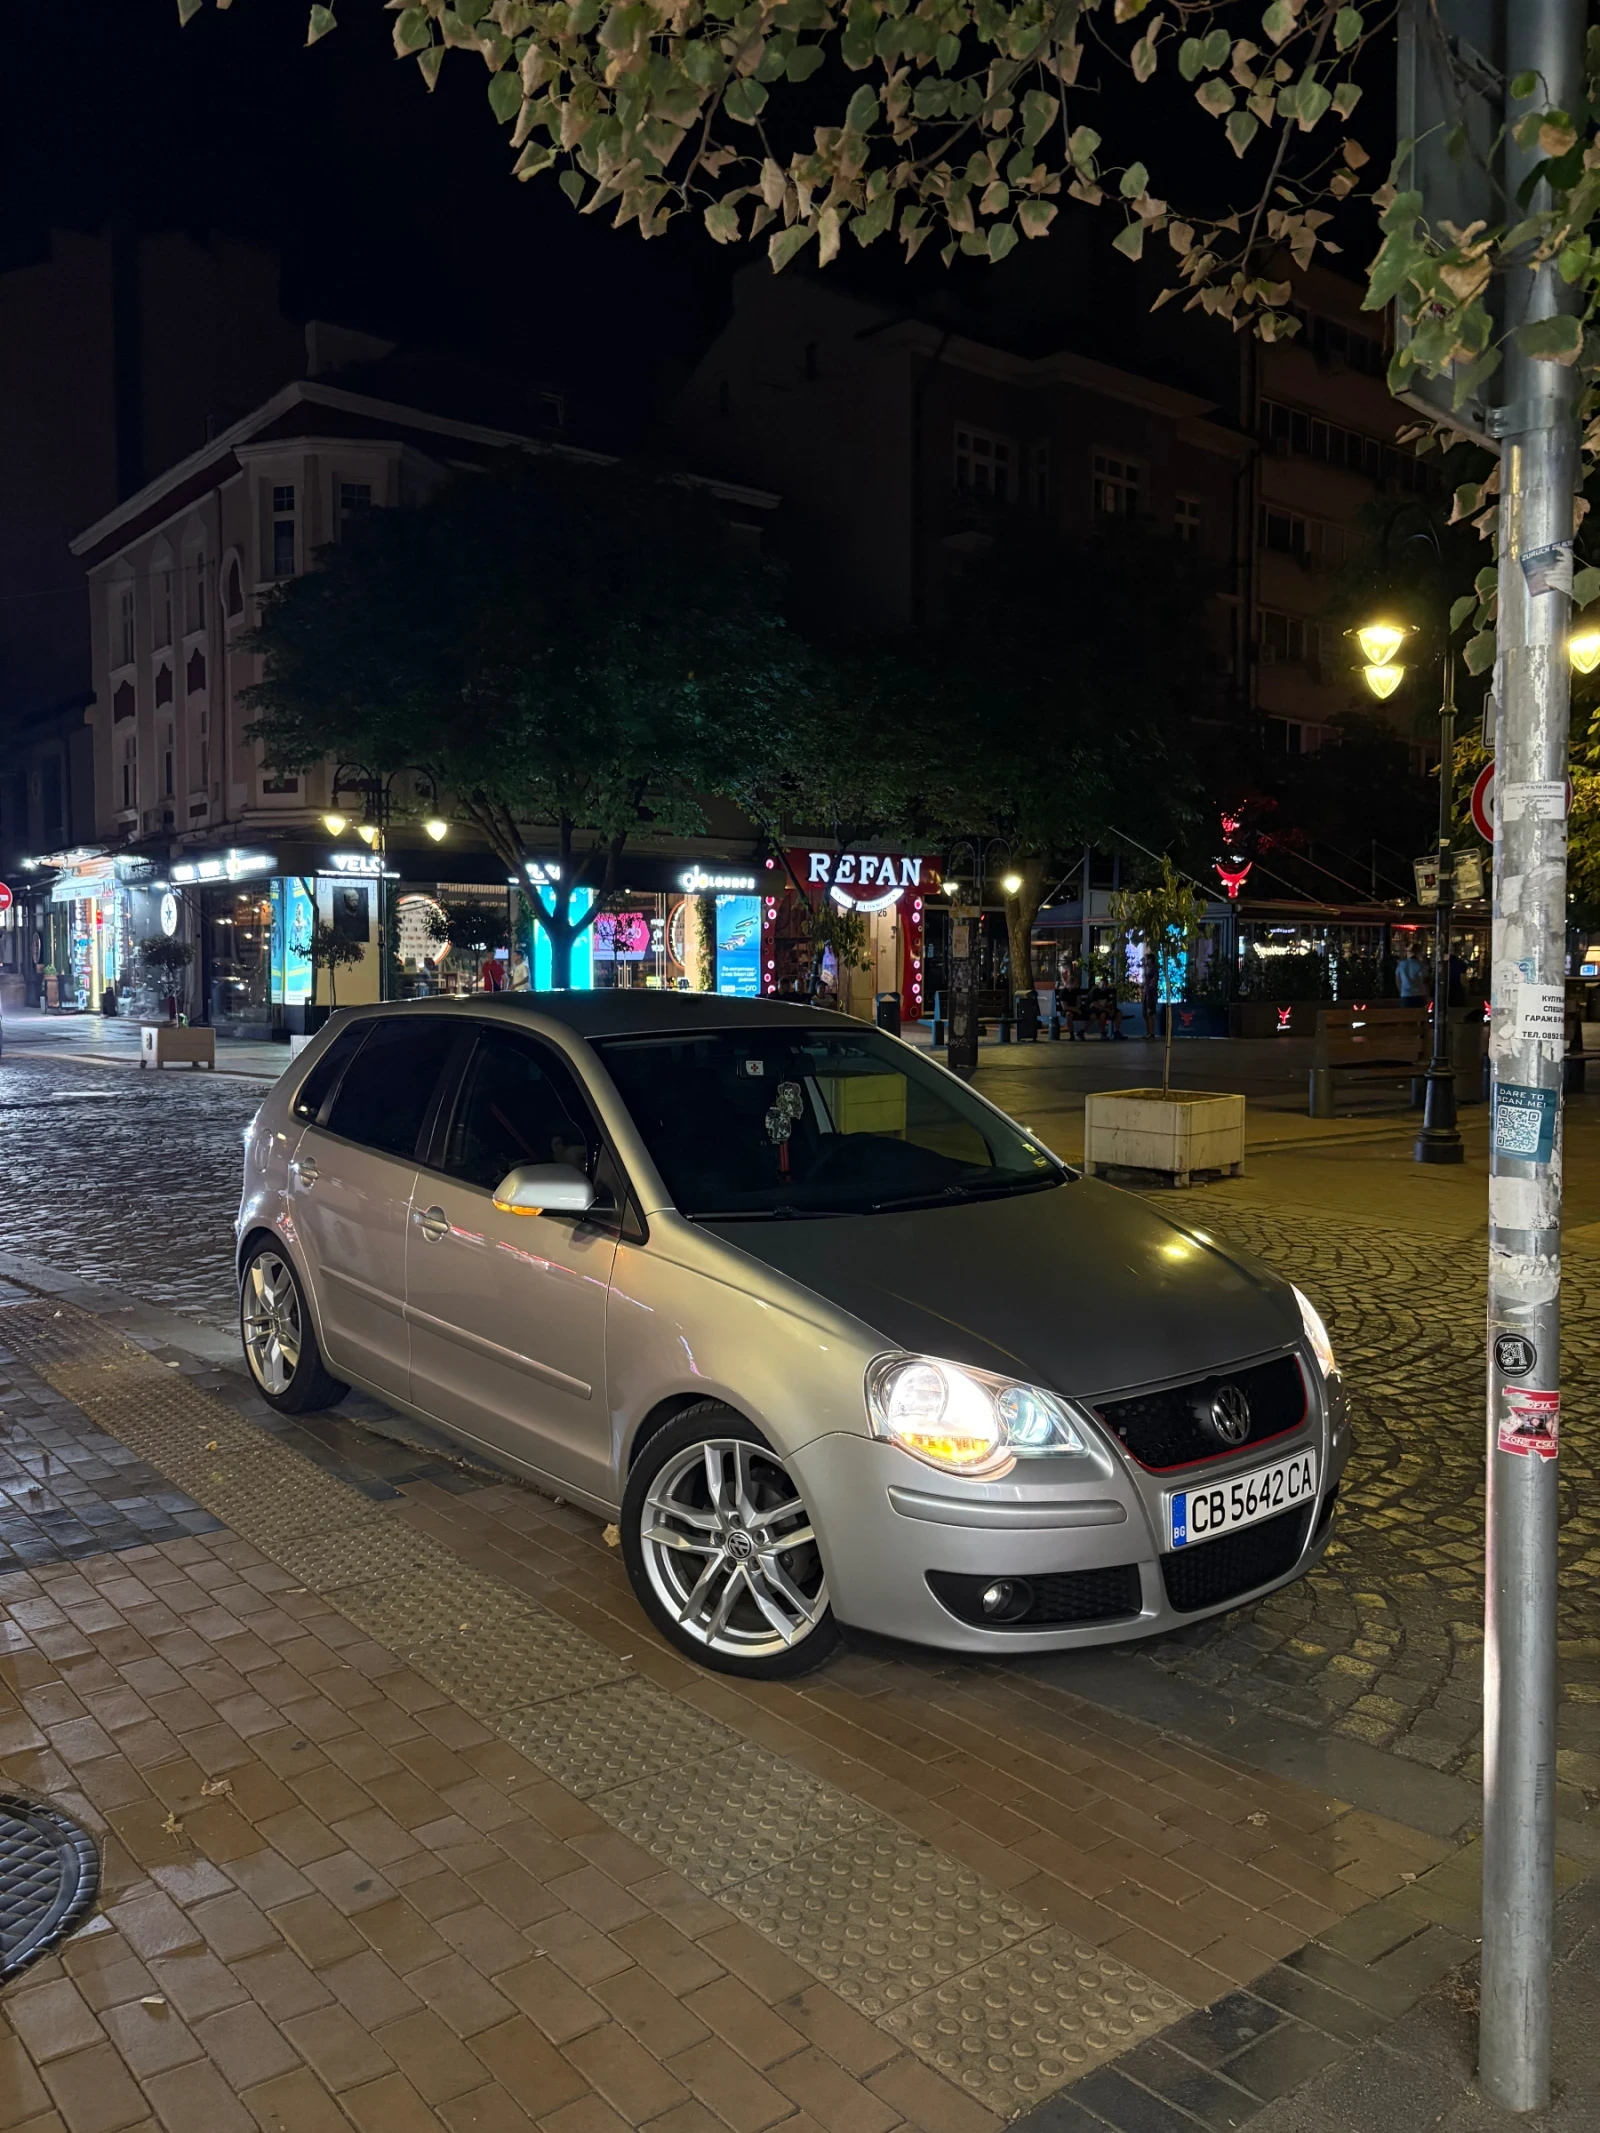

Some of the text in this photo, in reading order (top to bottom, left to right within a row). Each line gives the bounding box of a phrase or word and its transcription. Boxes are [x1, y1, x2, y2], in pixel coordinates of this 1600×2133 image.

[332, 855, 386, 872] VELO
[808, 852, 922, 886] REFAN
[682, 865, 709, 893] glo
[878, 908, 887, 918] 26
[1525, 1014, 1553, 1022] ГАРАЖ
[1522, 1031, 1541, 1039] ТЕЛ.
[1500, 1088, 1545, 1101] DARE TO
[1497, 1095, 1547, 1109] SCAN ME!
[1192, 1457, 1313, 1533] CB 5642 CA
[1173, 1525, 1186, 1539] BG
